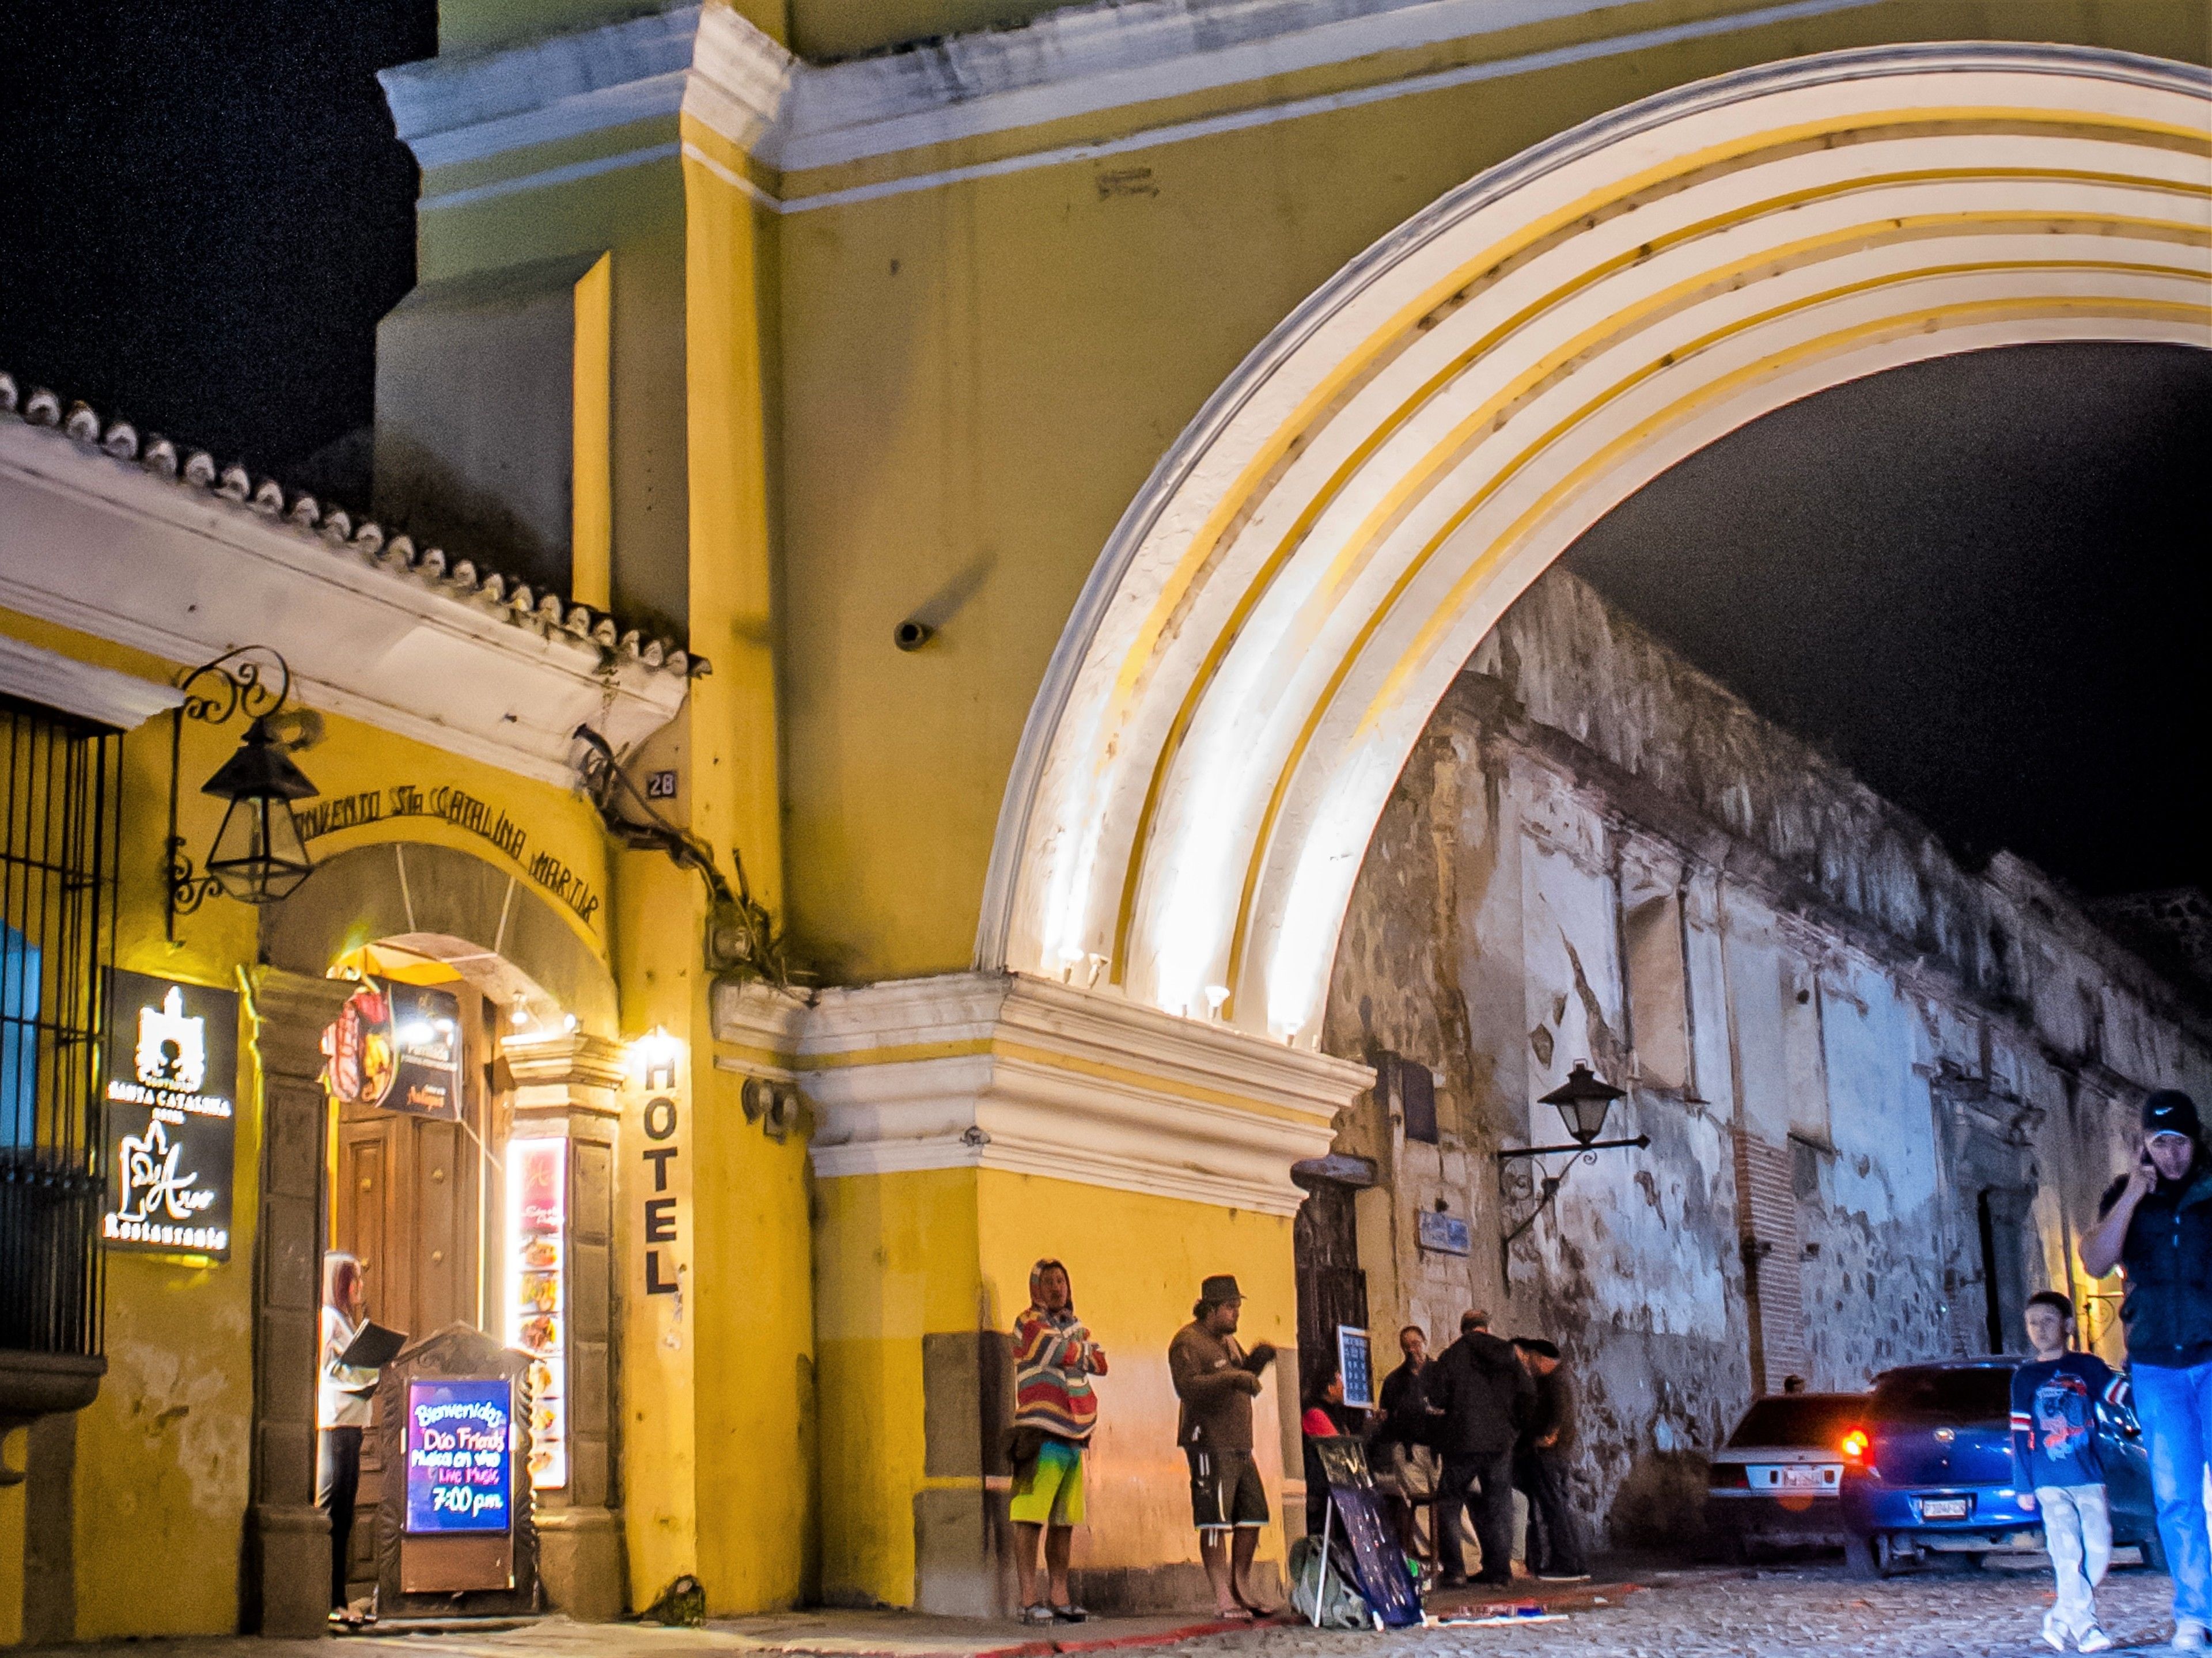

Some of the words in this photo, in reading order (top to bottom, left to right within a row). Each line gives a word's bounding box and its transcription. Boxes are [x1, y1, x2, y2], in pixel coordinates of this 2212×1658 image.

[650, 773, 674, 795] 28
[430, 786, 527, 861] CATALINA
[528, 850, 599, 924] MARTIR
[642, 1047, 680, 1295] HOTEL
[414, 1401, 503, 1428] Bienvenidos
[432, 1485, 473, 1513] 7:00
